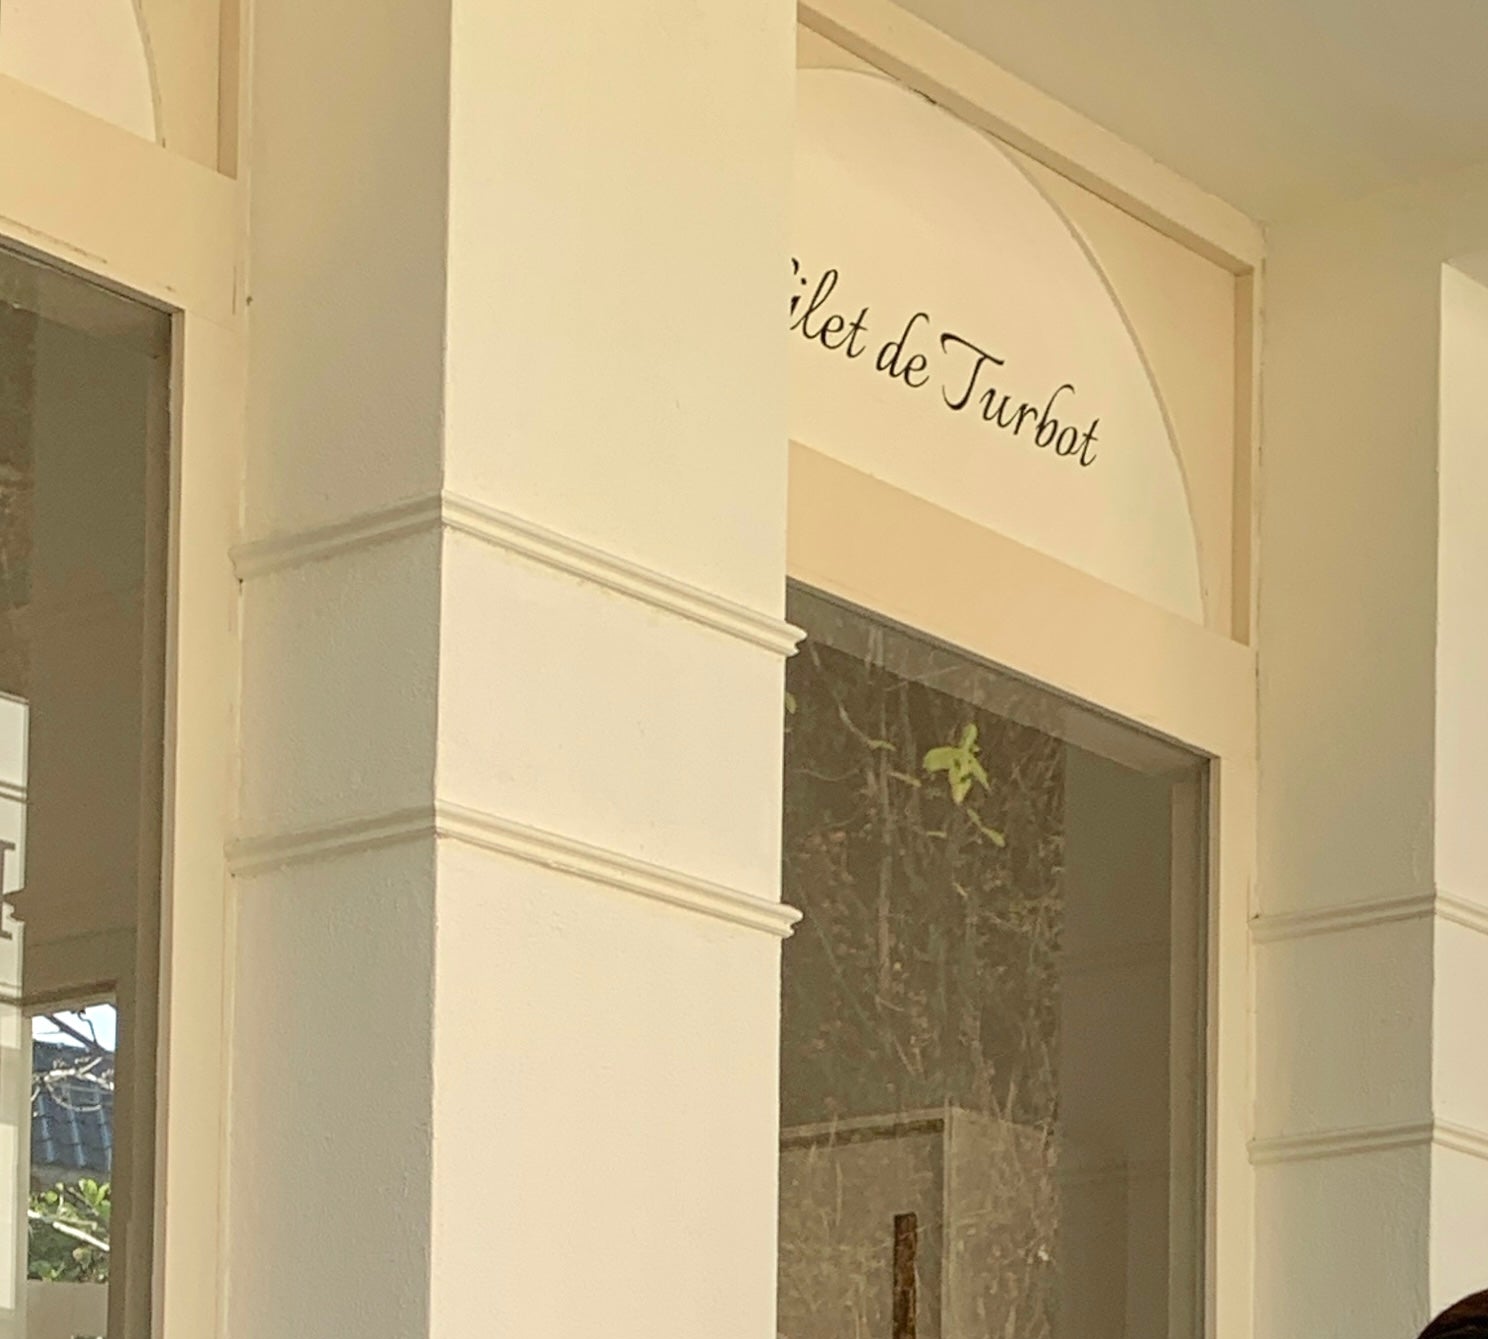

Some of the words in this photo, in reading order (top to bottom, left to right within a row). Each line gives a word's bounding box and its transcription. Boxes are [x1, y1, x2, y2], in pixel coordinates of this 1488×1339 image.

[790, 258, 869, 359] ilet
[876, 312, 931, 388] de
[940, 333, 1100, 467] Turbot
